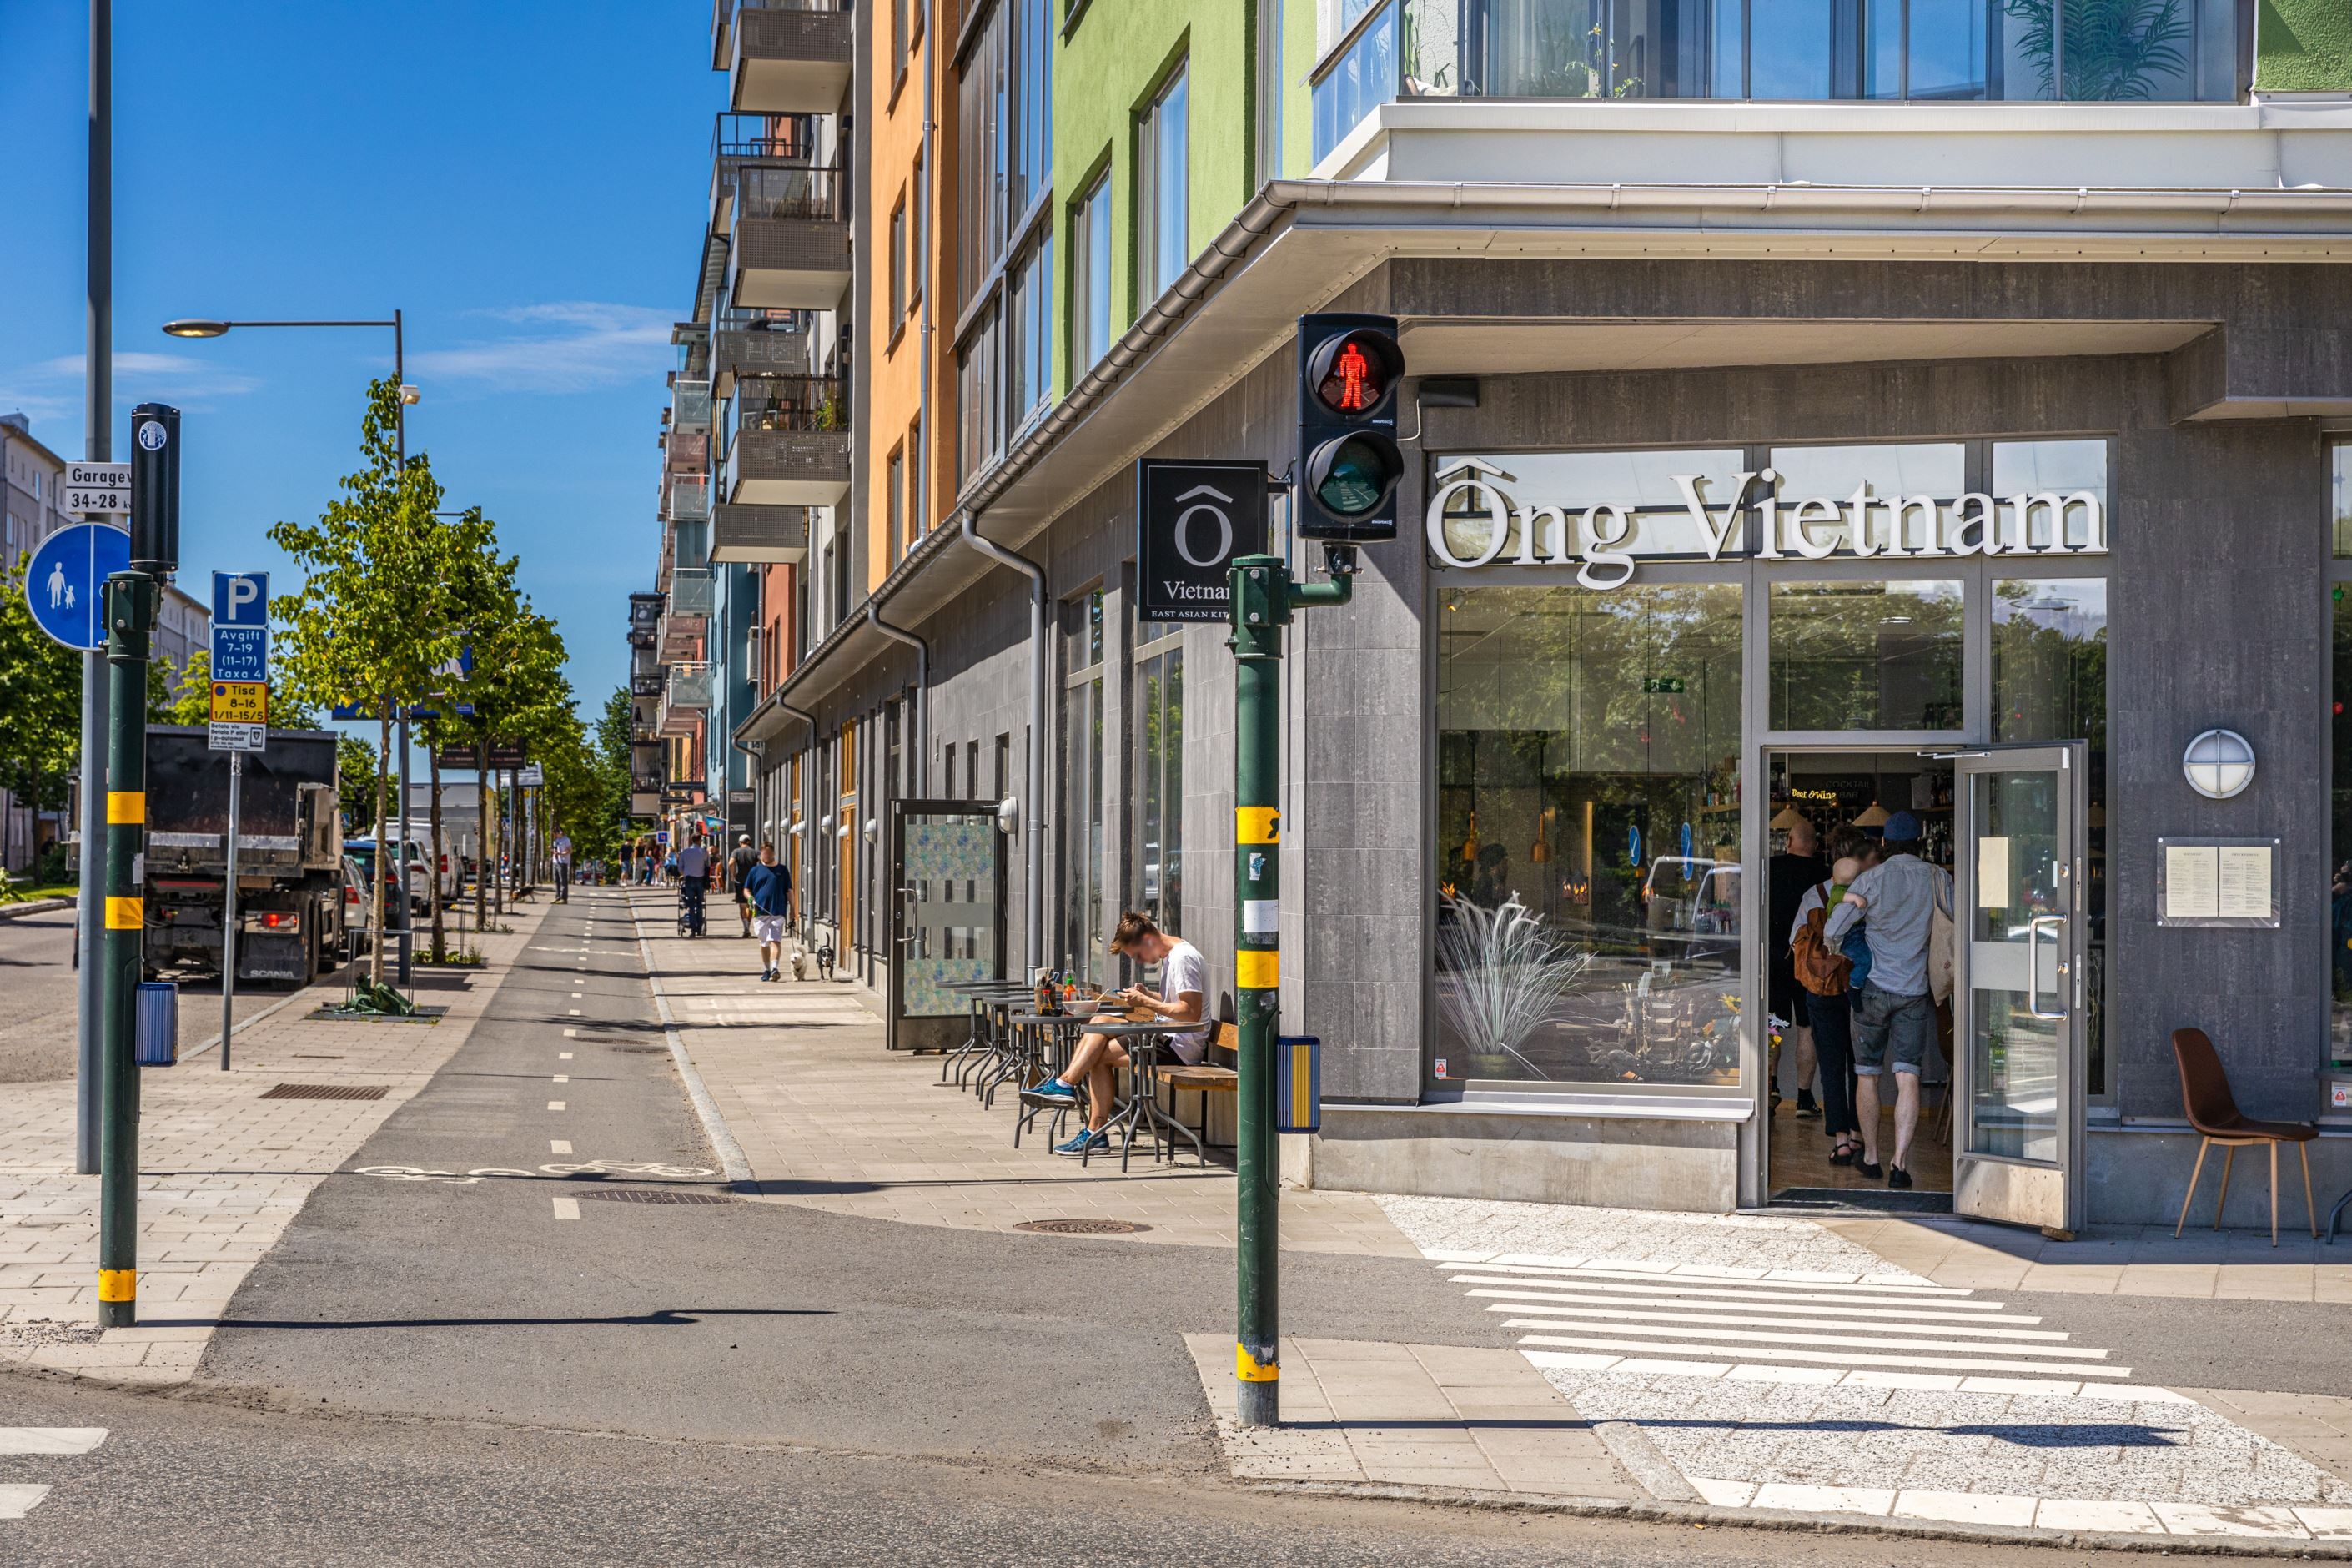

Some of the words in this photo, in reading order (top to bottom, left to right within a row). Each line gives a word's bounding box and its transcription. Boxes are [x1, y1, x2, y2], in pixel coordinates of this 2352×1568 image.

[72, 494, 117, 508] 34-28
[1174, 485, 1234, 567] Ô
[1426, 456, 1636, 591] Ông
[1670, 467, 2108, 561] Vietnam
[1163, 580, 1229, 600] Vietna
[228, 578, 258, 620] P
[220, 630, 259, 641] Avgift
[227, 644, 253, 653] 7-19
[222, 656, 257, 666] (11-17)
[218, 669, 248, 678] Taxa
[254, 670, 261, 678] 4
[232, 686, 255, 695] Tisd
[230, 699, 256, 707] 8-16
[214, 711, 264, 720] 1/11-15/5
[250, 970, 294, 978] SCANIA
